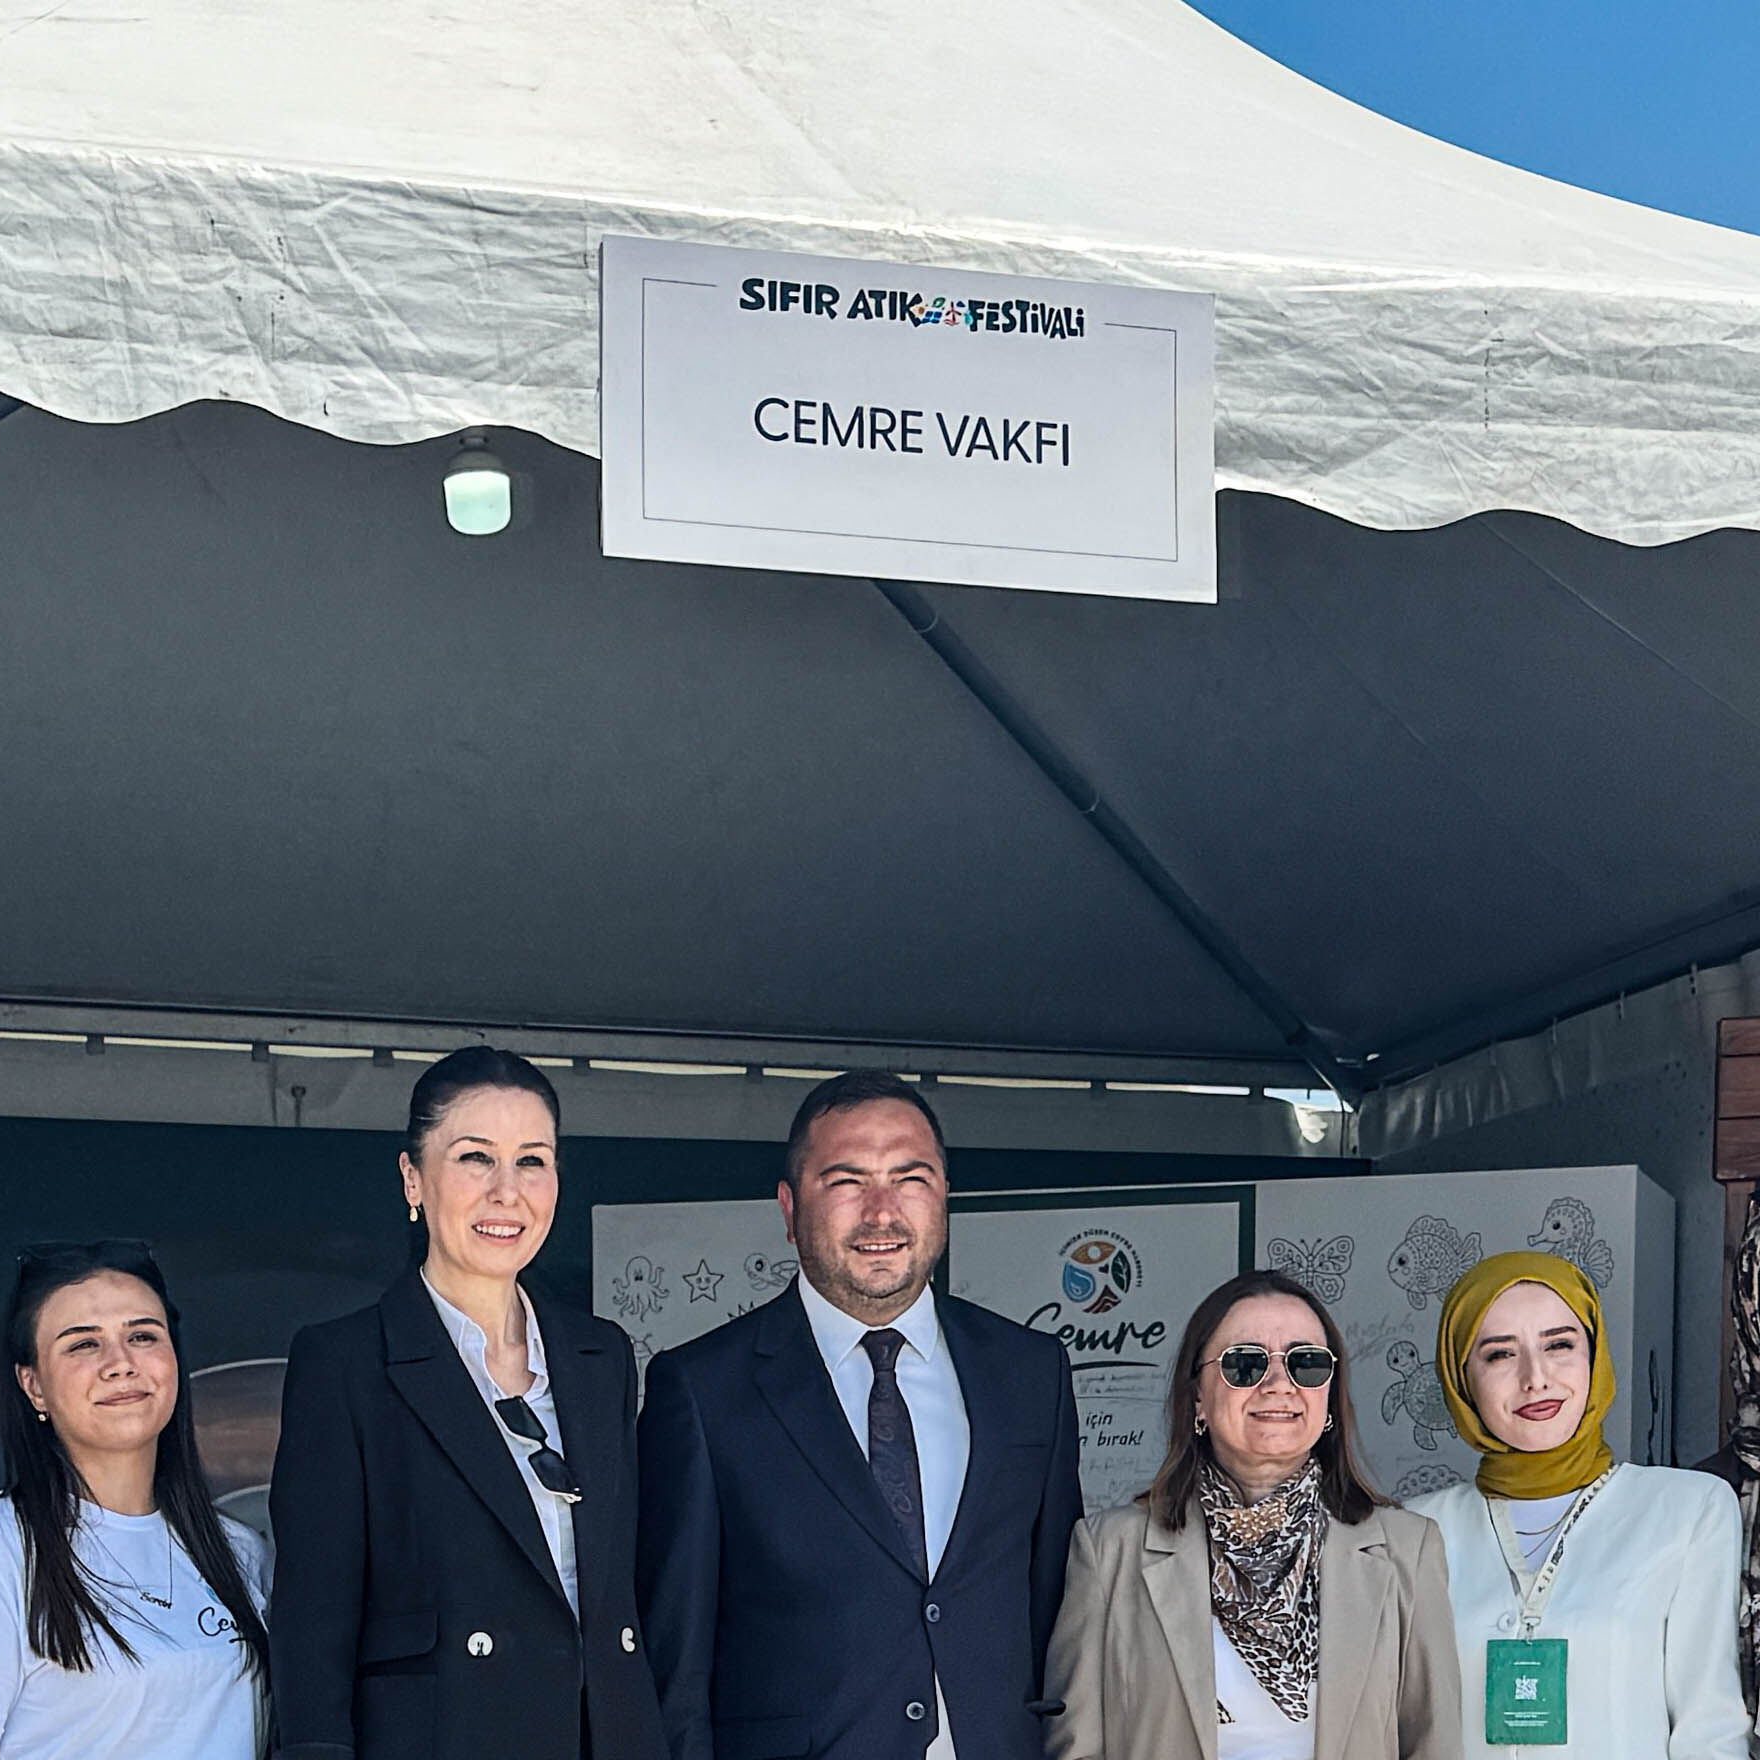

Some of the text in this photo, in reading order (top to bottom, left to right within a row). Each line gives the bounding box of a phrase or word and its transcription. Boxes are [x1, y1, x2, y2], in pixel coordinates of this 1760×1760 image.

[739, 277, 841, 320] SIFIR
[846, 288, 923, 328] ATIK
[753, 397, 1070, 467] CEMRE VAKFI
